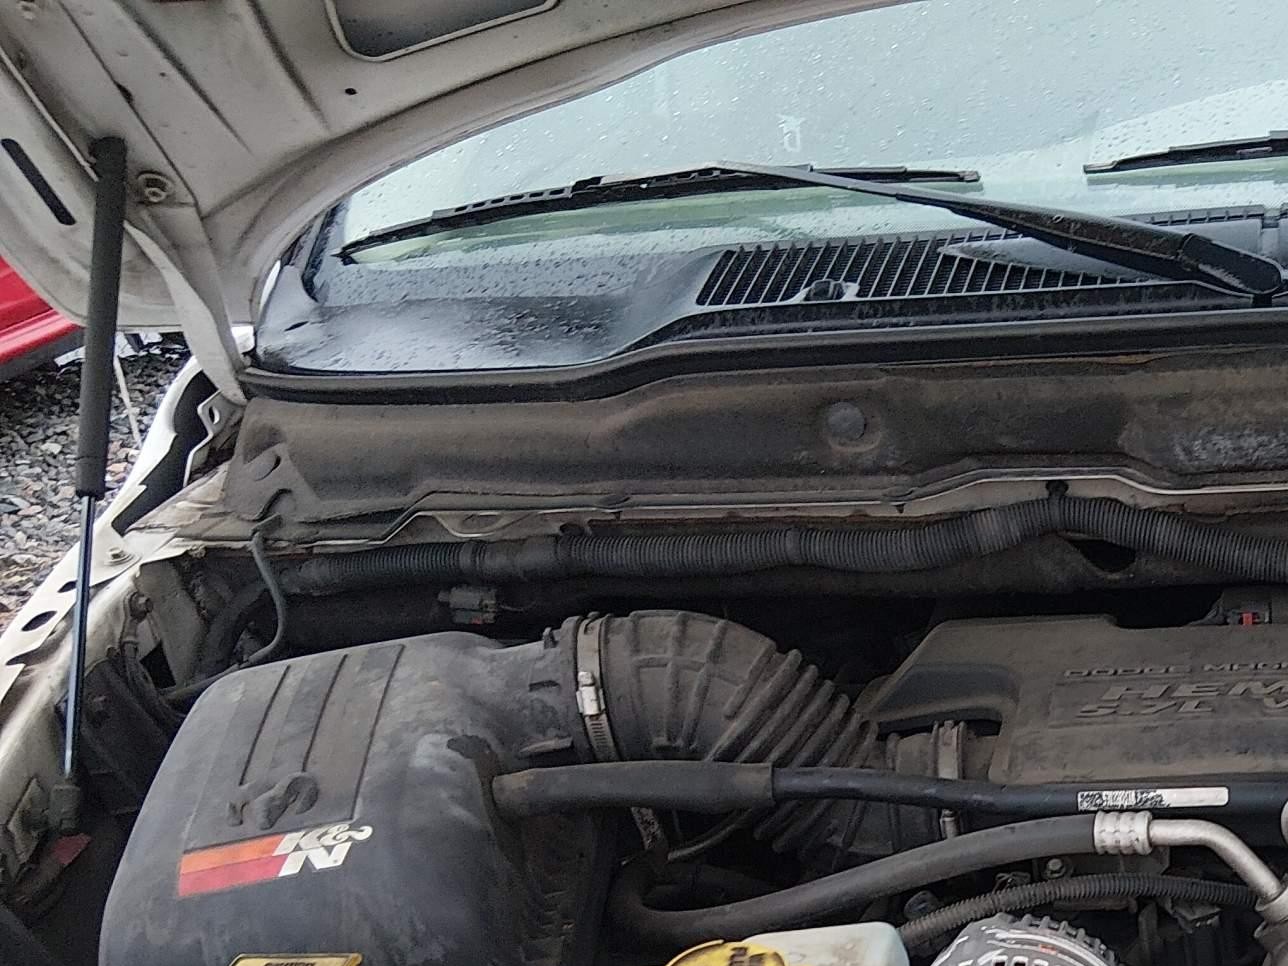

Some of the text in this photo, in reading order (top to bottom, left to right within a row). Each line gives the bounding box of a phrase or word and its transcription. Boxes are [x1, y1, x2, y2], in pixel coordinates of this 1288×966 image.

[1062, 665, 1192, 679] DODGE
[1074, 700, 1215, 719] 5.7L
[272, 822, 374, 878] K&N
